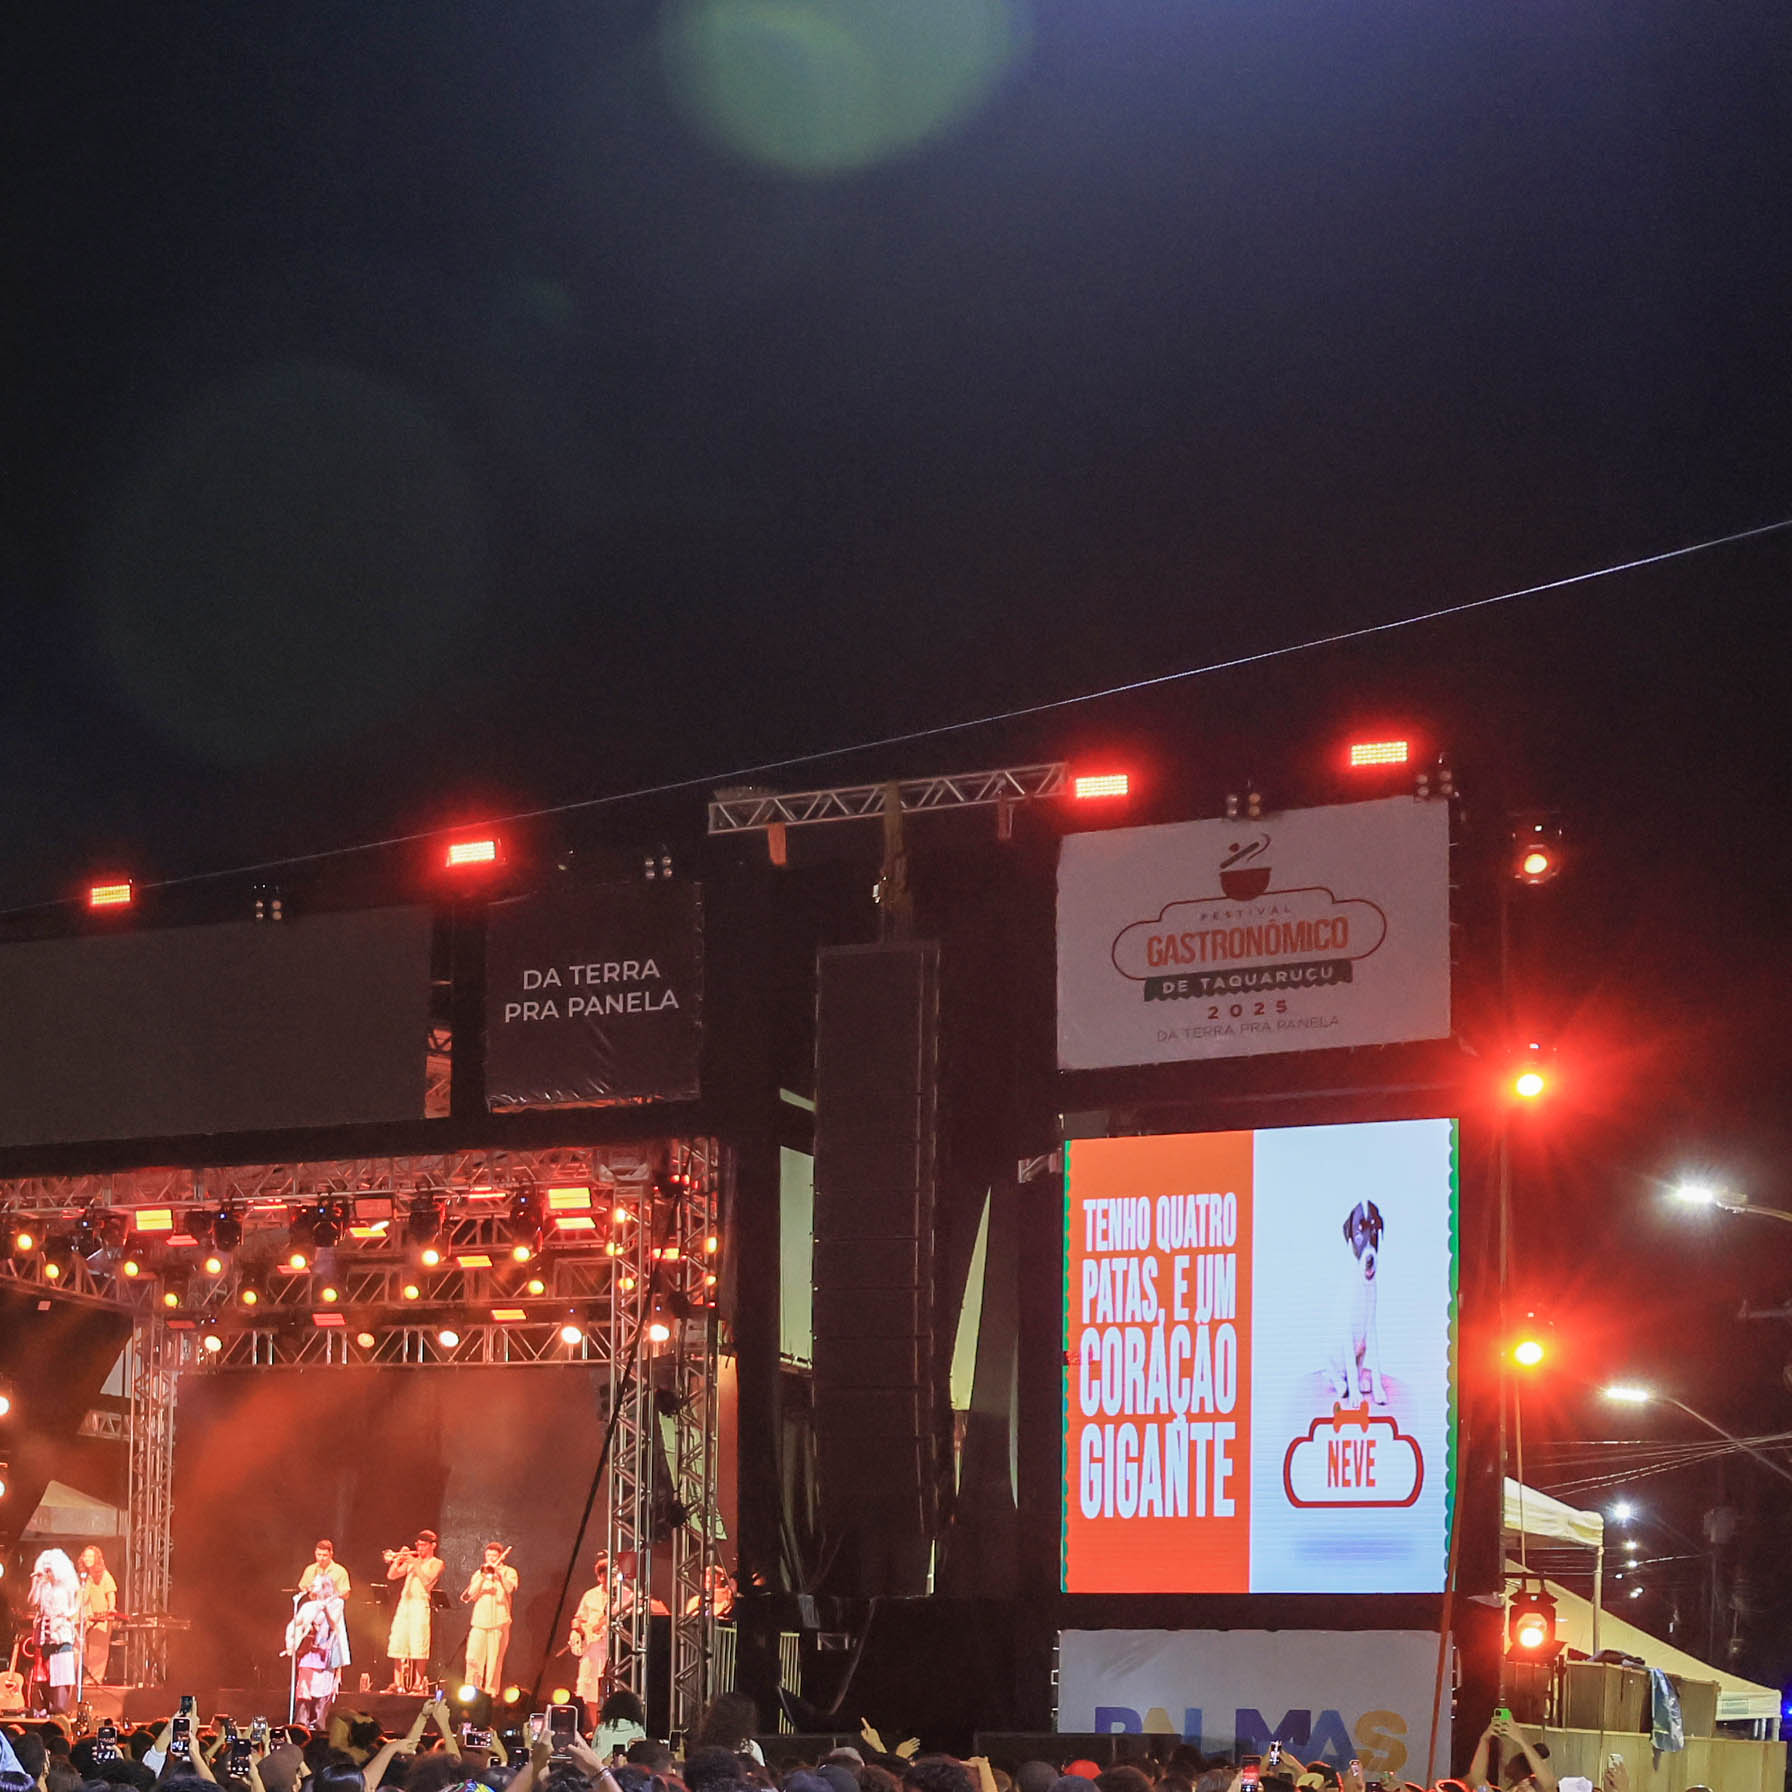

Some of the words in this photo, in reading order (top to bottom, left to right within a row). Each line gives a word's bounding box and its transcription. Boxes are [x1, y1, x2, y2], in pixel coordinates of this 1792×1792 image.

[1200, 905, 1292, 921] FESTIVAL
[1147, 917, 1348, 967] GASTRONÔMICO
[523, 967, 562, 990] DA
[569, 958, 660, 986] TERRA
[1162, 979, 1189, 994] DE
[1200, 966, 1334, 991] TAQUARUÇU
[505, 1000, 559, 1023] PRA
[568, 989, 679, 1018] PANELA
[1207, 1000, 1288, 1020] 2025
[1157, 1029, 1179, 1042] DA
[1185, 1025, 1235, 1040] TERRA
[1240, 1021, 1271, 1034] PRA
[1276, 1015, 1340, 1032] PANELA
[1083, 1196, 1151, 1252] TENHO
[1156, 1192, 1237, 1254] QUATRO
[1082, 1256, 1165, 1326] PATAS,
[1174, 1255, 1190, 1321] E
[1195, 1253, 1236, 1324] UM
[1080, 1319, 1237, 1421] CORAÇÃO
[1080, 1421, 1236, 1519] GIGANTE
[1327, 1440, 1376, 1488] NEVE
